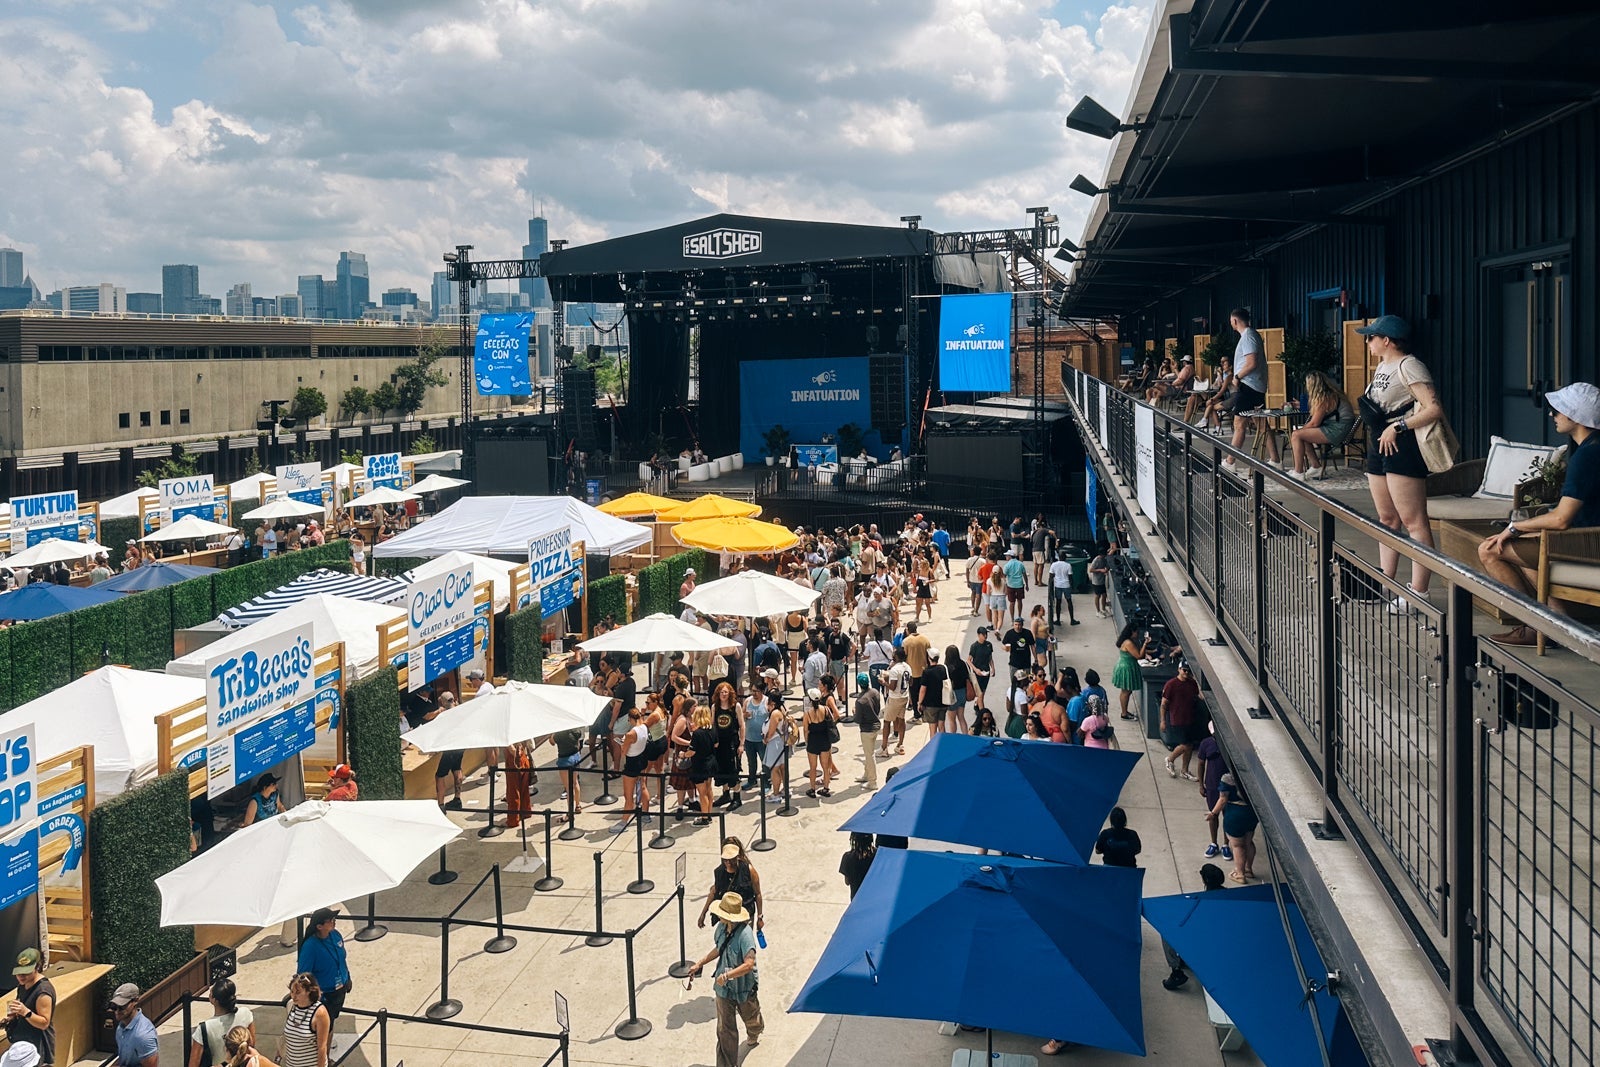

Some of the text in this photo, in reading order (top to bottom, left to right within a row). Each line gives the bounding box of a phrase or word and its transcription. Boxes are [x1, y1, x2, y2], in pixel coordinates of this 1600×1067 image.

[690, 232, 722, 255] SALT
[722, 231, 760, 255] SHED
[491, 350, 510, 360] CON
[945, 340, 1005, 351] INFATUATION
[791, 389, 860, 402] INFATUATION
[162, 479, 211, 497] TOMA
[530, 528, 571, 561] PROFESSOR
[531, 548, 572, 585] PIZZA
[411, 570, 472, 629] Ciao Ciao
[420, 611, 465, 638] GELATO & CAFE
[210, 635, 312, 709] TriBecca's
[217, 690, 274, 728] sandwich
[275, 679, 300, 703] shop
[320, 690, 331, 700] PICK
[331, 690, 337, 699] UP
[186, 750, 203, 765] HERE
[42, 788, 82, 811] Los Angeles, CA
[48, 815, 83, 850] ORDER HERE
